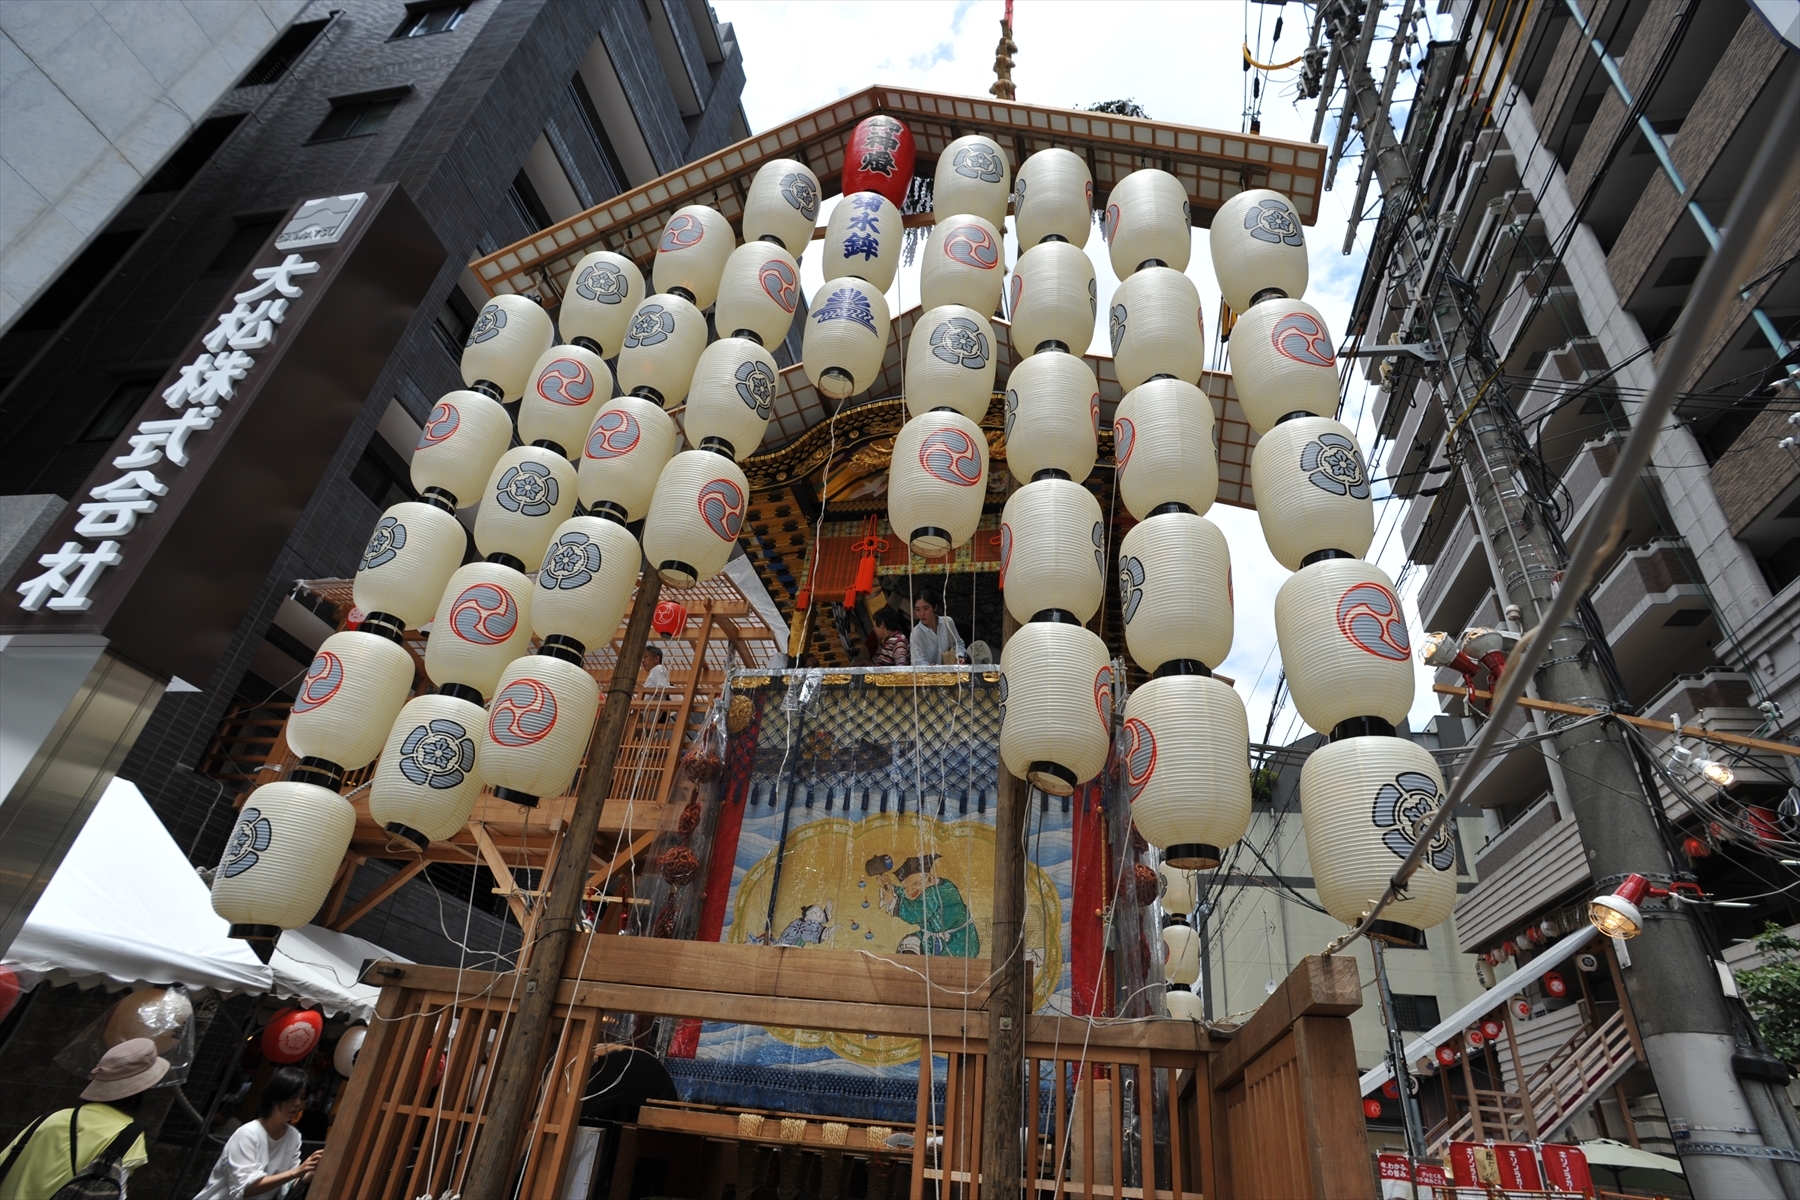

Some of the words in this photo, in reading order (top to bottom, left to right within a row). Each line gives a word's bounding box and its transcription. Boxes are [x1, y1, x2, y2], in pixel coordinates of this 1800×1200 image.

[858, 117, 904, 178] 御神燈
[842, 193, 885, 262] 菊水鉾
[16, 253, 322, 612] 大松株式会社
